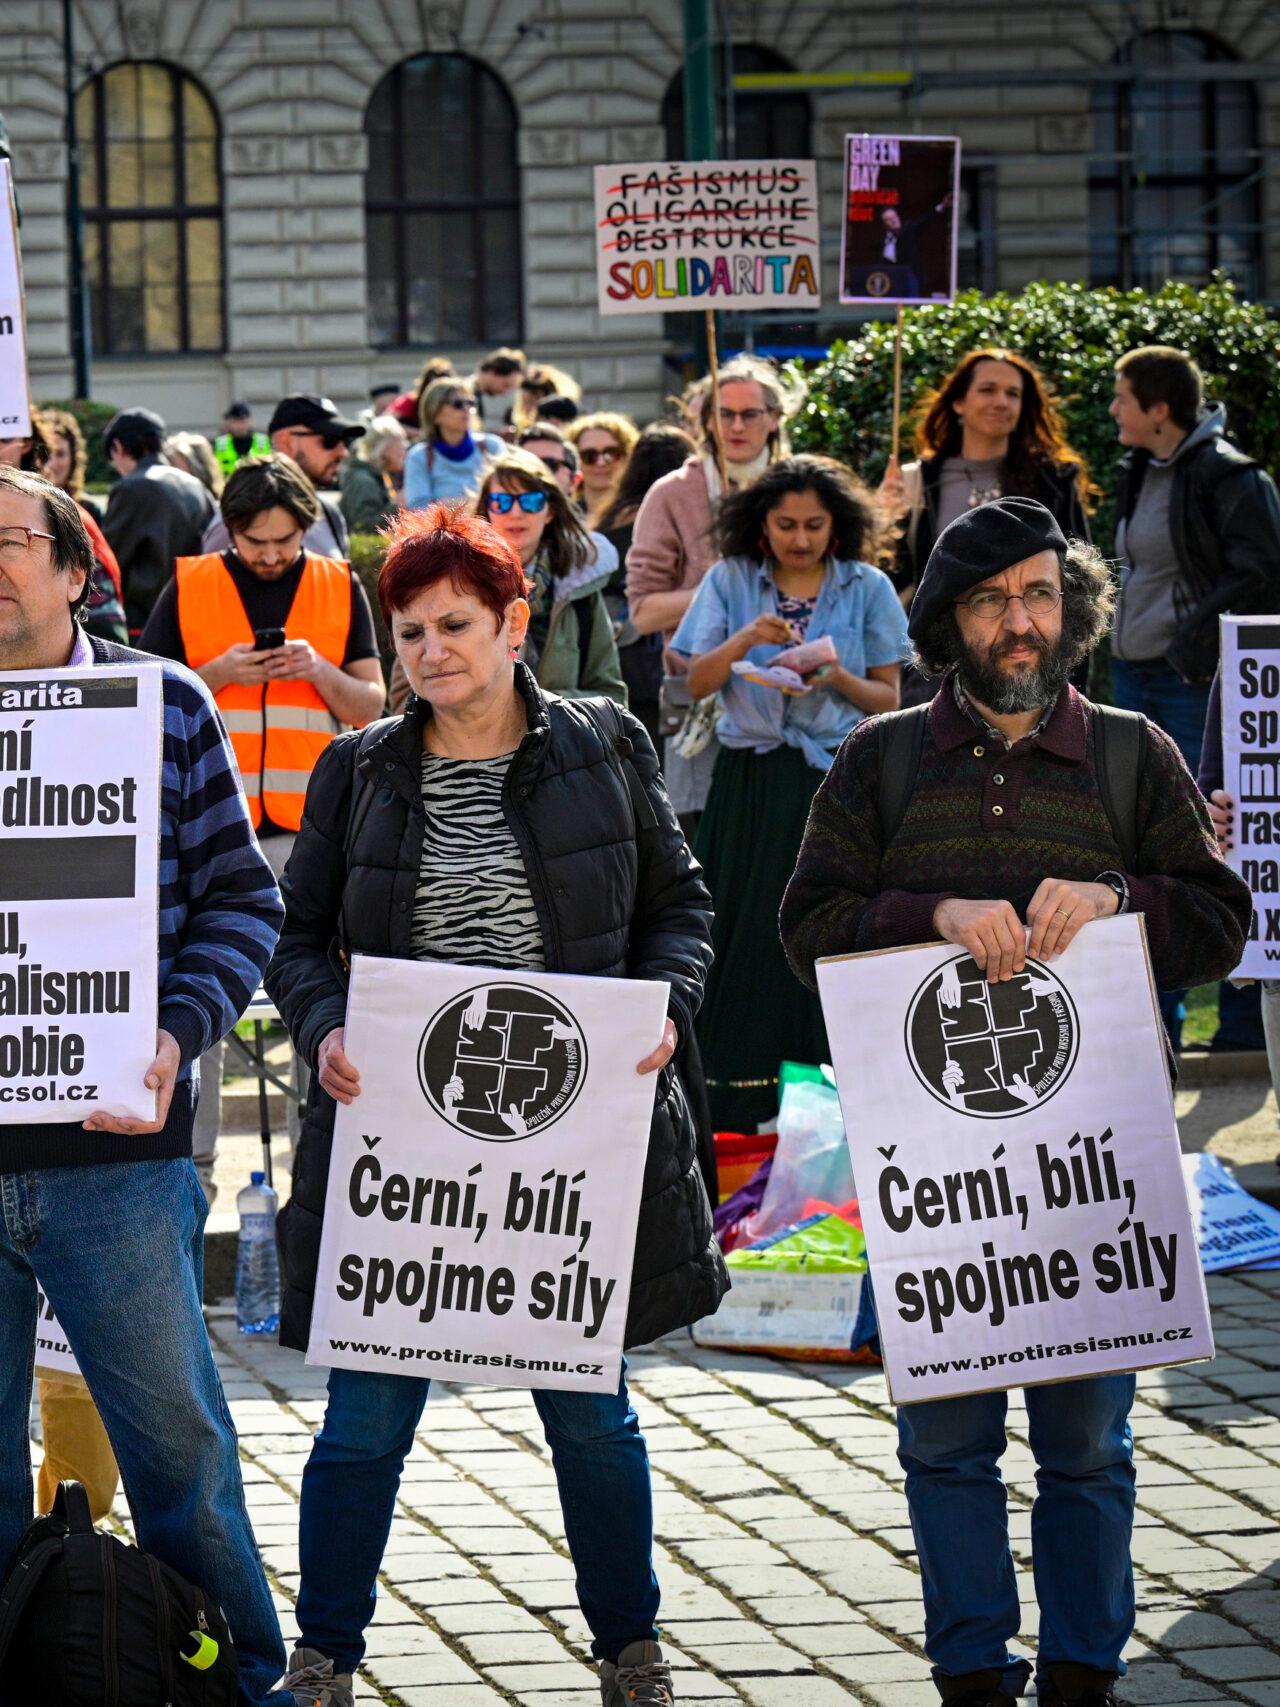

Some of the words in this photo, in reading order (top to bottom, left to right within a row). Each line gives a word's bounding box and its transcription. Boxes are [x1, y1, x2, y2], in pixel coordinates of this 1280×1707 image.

[620, 166, 800, 198] FAŠISMUS
[849, 165, 880, 191] DAY
[607, 199, 809, 226] OLIGARCHIE
[616, 225, 796, 252] DESTRUKCE
[607, 255, 818, 300] SOLIDARITA
[349, 1135, 488, 1243] Černí,
[503, 1168, 592, 1253] bílí,
[877, 1143, 1029, 1233] Černí,
[1035, 1127, 1136, 1215] bílí,
[336, 1246, 515, 1324] spojme
[528, 1253, 616, 1339] síly
[895, 1241, 1081, 1334] spojme
[1092, 1216, 1178, 1303] síly
[329, 1339, 604, 1376] www.protirasismu.cz
[908, 1325, 1193, 1379] www.protirasismu.cz
